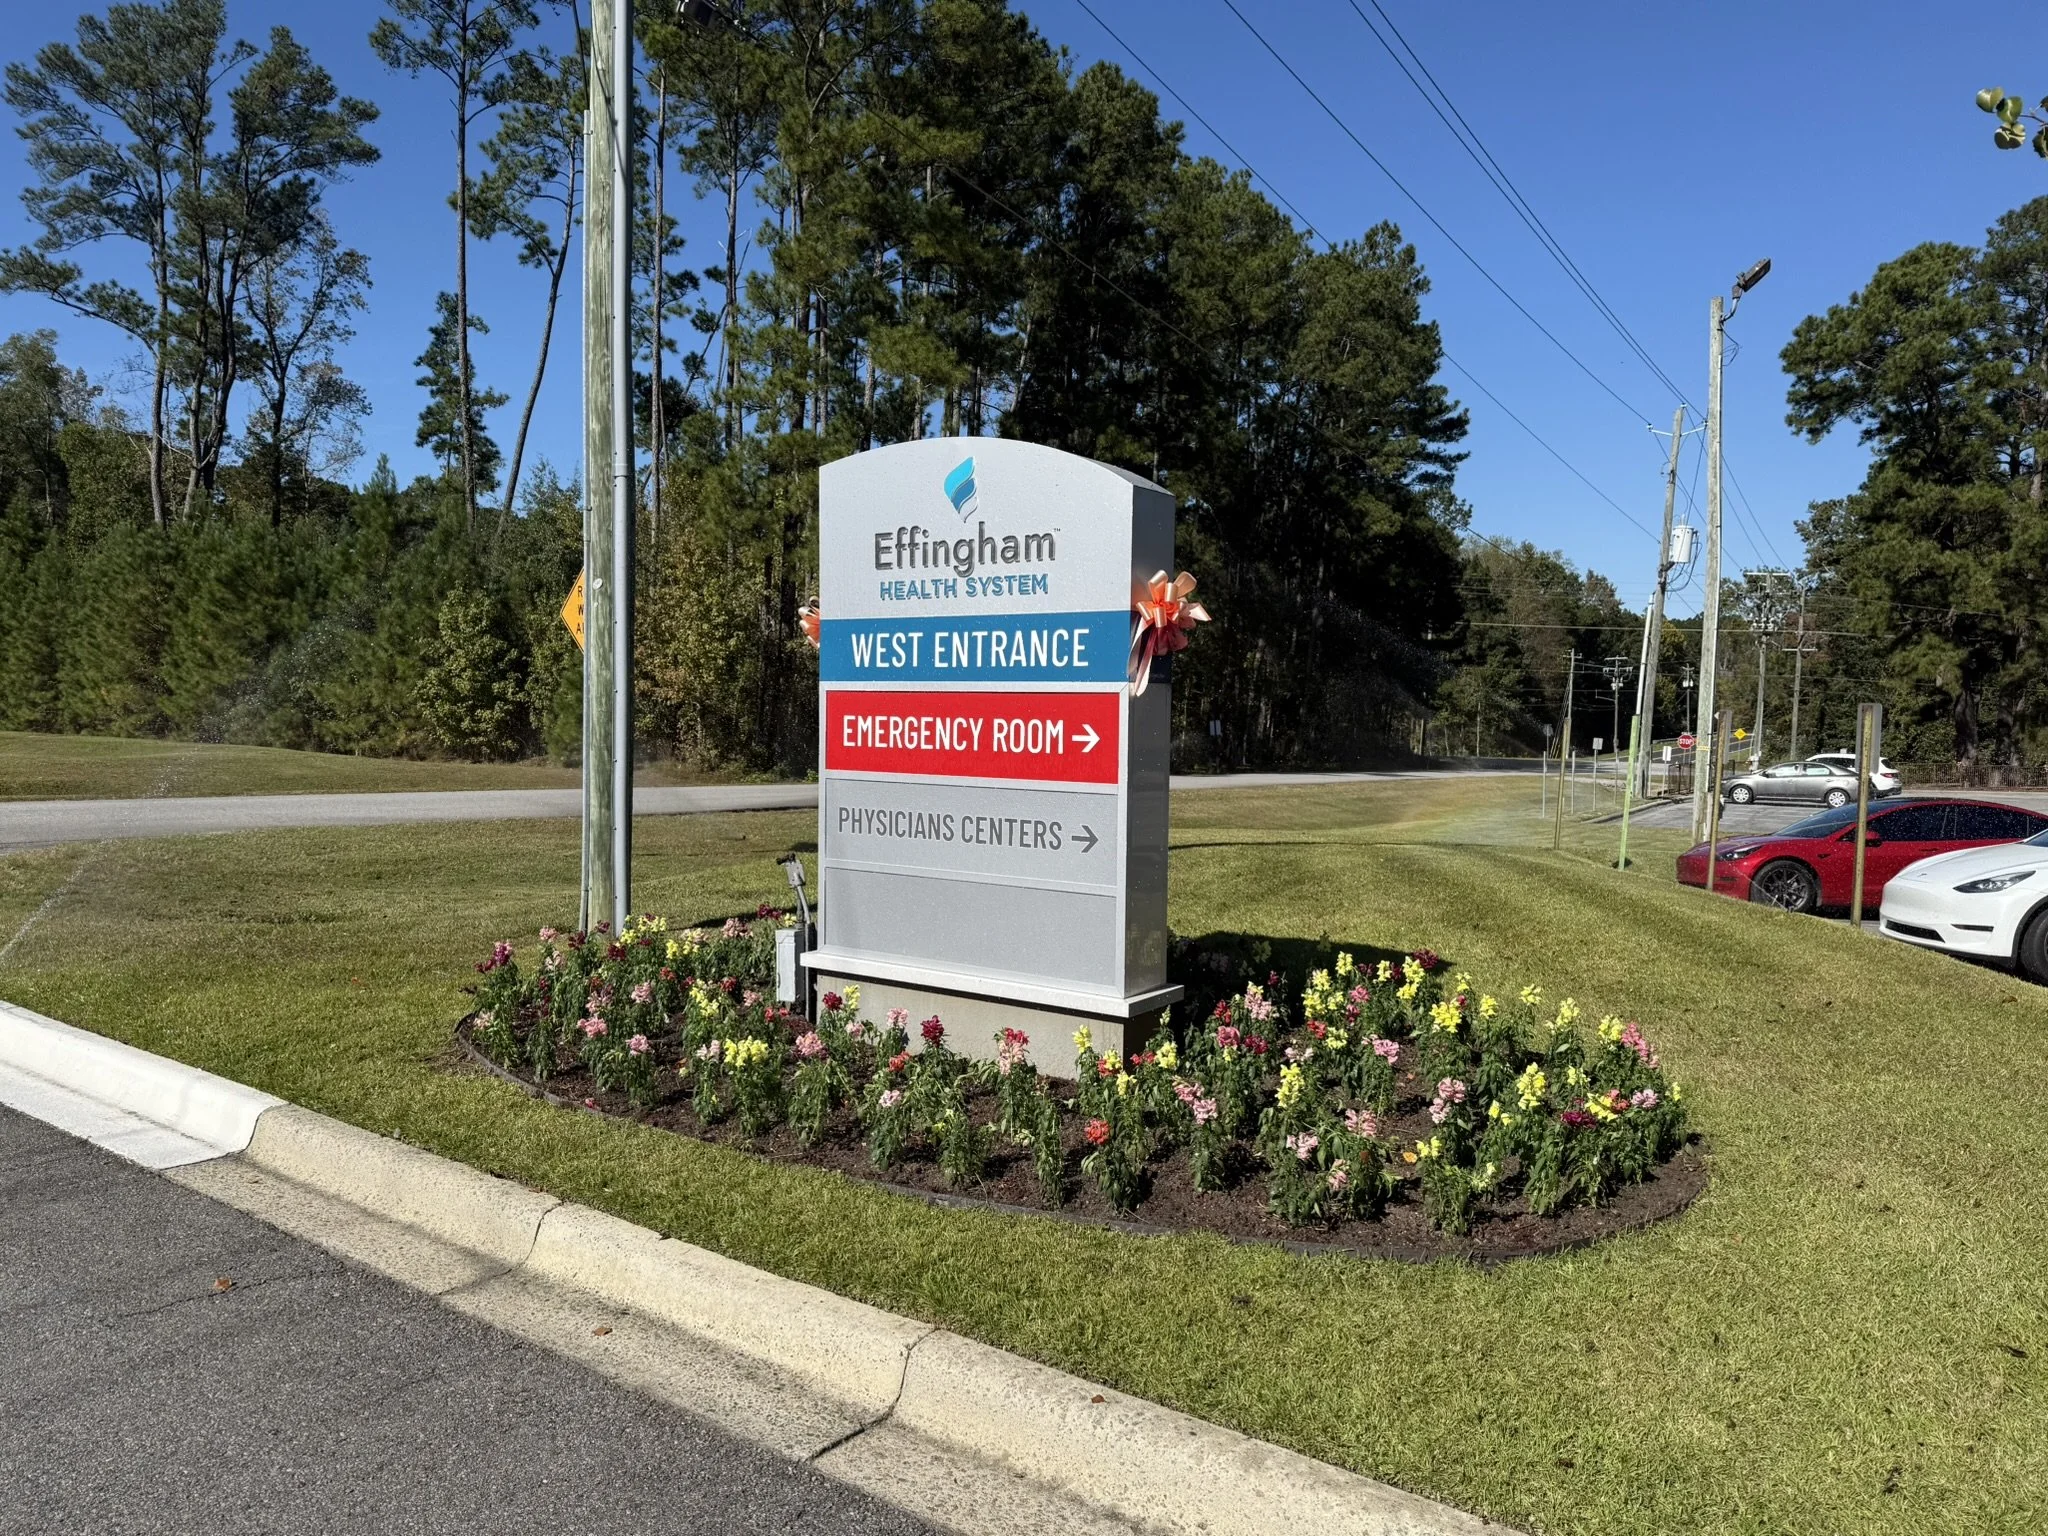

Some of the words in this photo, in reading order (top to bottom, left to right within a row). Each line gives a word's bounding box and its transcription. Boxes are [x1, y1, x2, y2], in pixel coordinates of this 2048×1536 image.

[880, 578, 958, 600] HEALTH
[965, 573, 1049, 598] SYSTEM
[851, 632, 923, 668] WEST
[934, 628, 1090, 668] ENTRANCE
[843, 715, 983, 752] EMERGENCY
[992, 718, 1064, 754] ROOM
[839, 807, 955, 841] PHYSICIANS
[961, 815, 1062, 850] CENTERS
